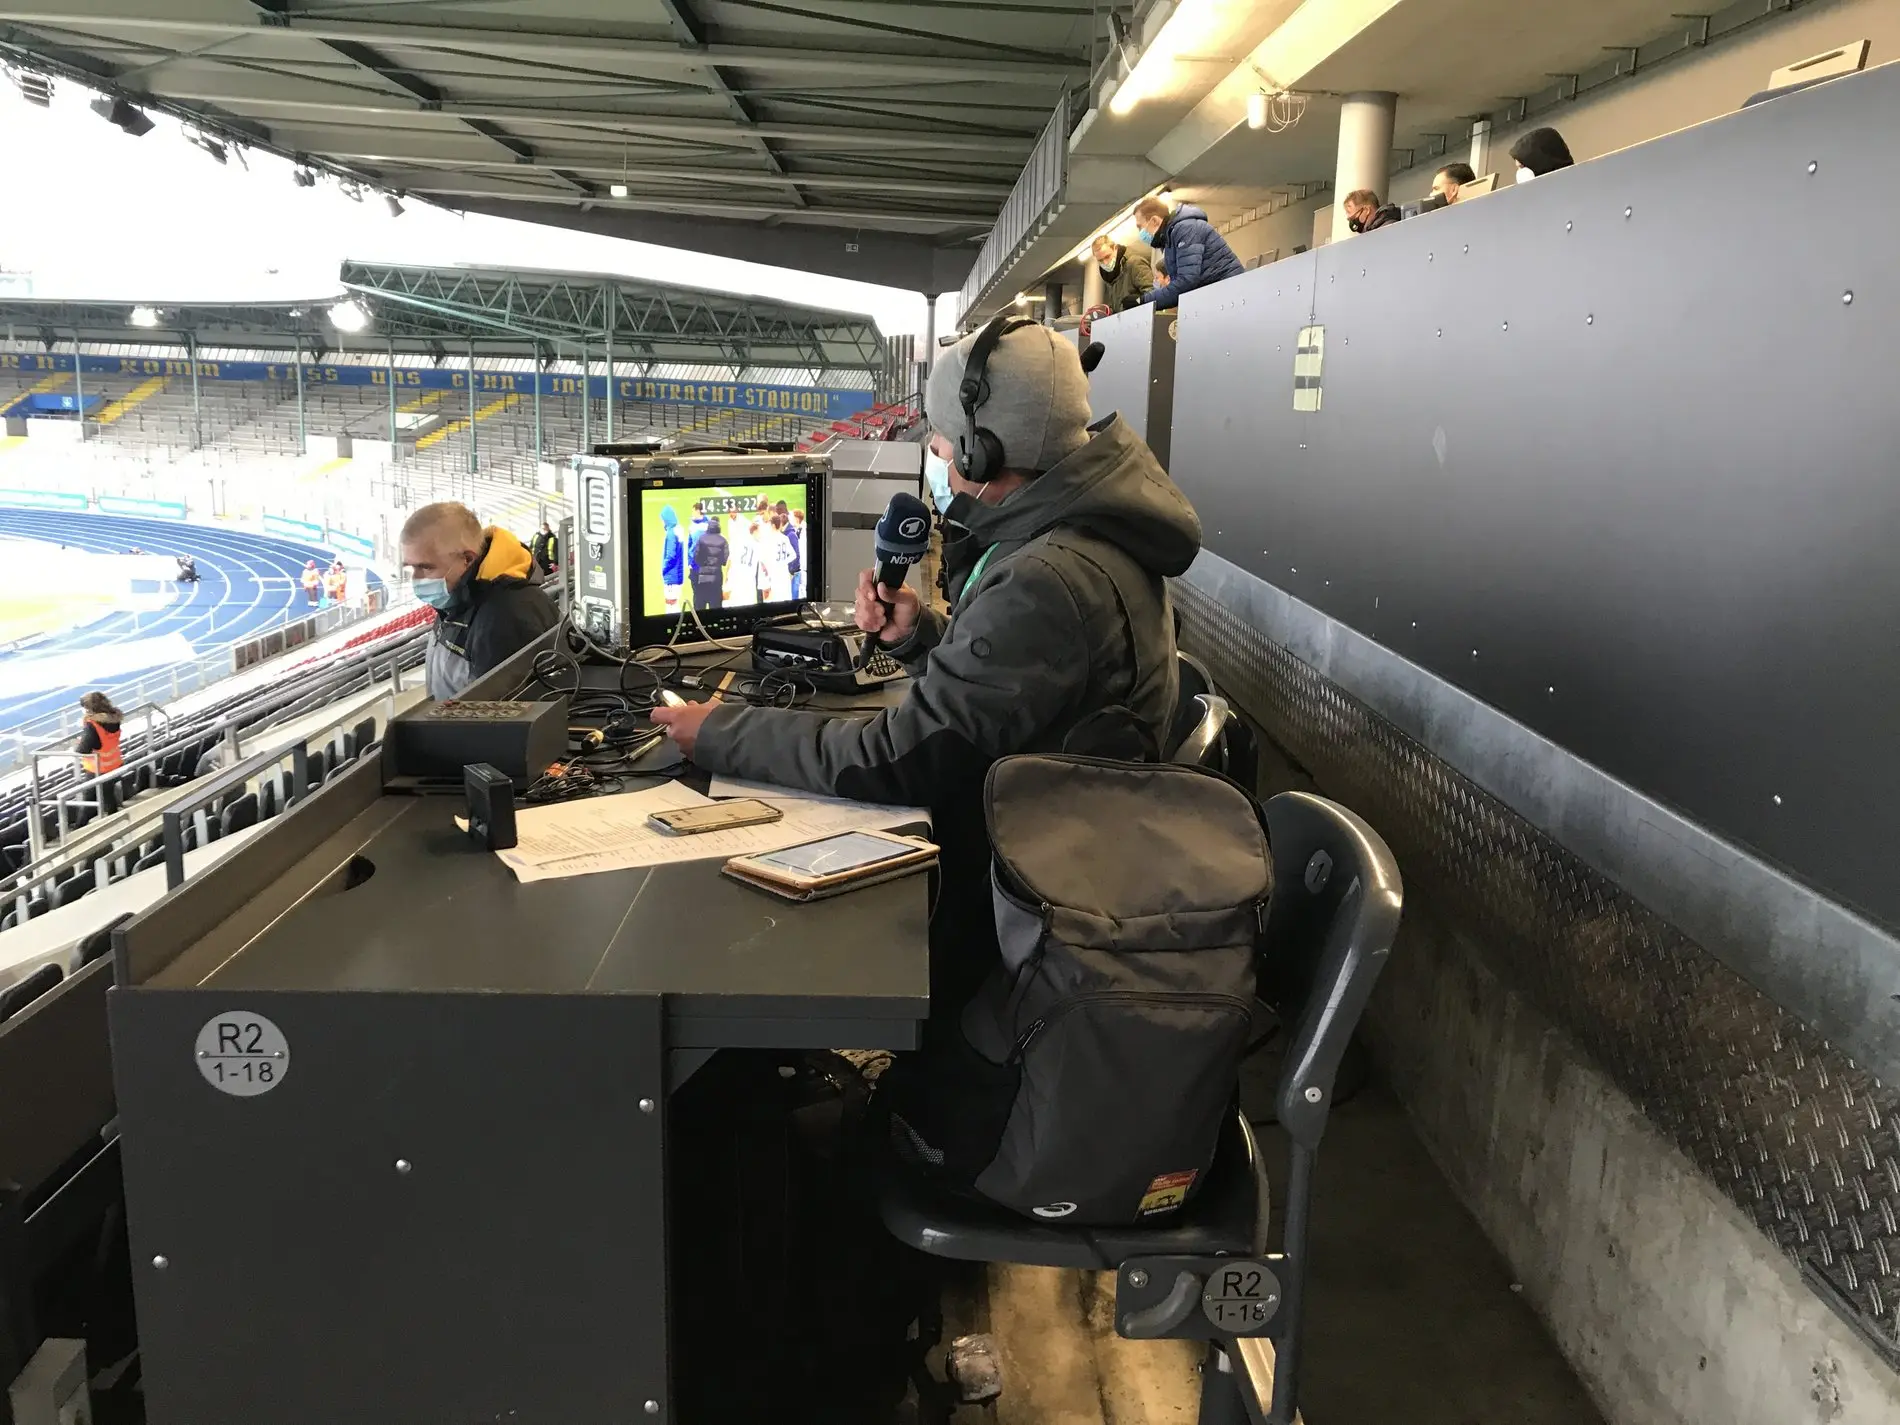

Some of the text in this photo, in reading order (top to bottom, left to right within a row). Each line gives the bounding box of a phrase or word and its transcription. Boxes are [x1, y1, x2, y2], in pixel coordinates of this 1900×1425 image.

[701, 497, 757, 513] 14:53:22
[890, 553, 915, 565] NDR
[218, 1022, 264, 1054] R2
[213, 1061, 273, 1083] 1-18
[1222, 1270, 1262, 1297] R2
[1215, 1303, 1266, 1322] 1-18
